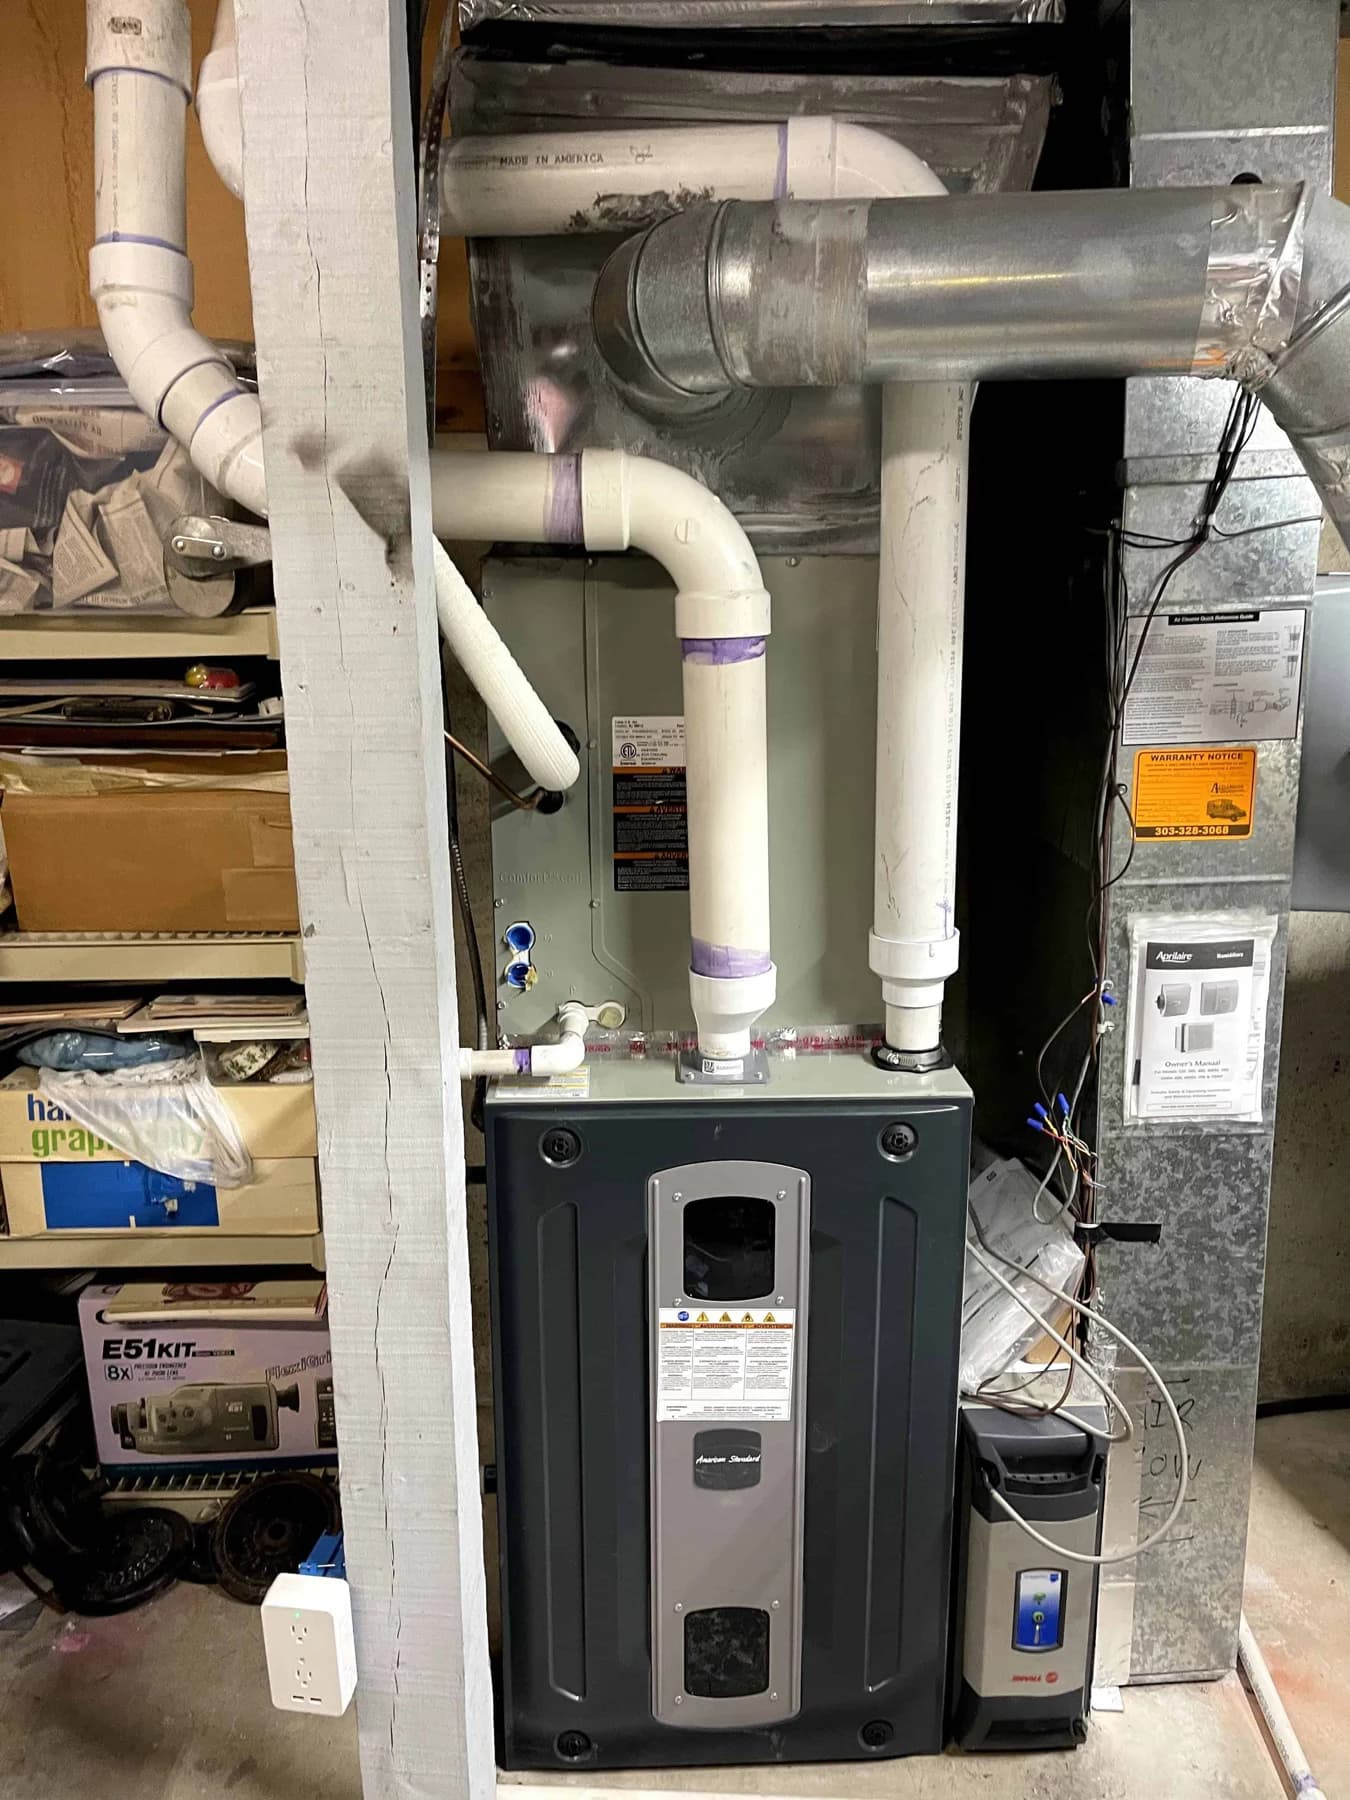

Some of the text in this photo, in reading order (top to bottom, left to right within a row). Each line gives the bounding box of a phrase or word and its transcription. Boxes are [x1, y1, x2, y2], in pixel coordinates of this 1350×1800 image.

[500, 157, 529, 166] MADE
[536, 156, 548, 165] IN
[554, 154, 604, 165] AMERICA
[1150, 752, 1243, 762] WARRANTY NOTICE
[1156, 951, 1193, 963] Aprilaire
[1165, 1059, 1221, 1068] Owner's Manual
[695, 1454, 761, 1465] American Standard
